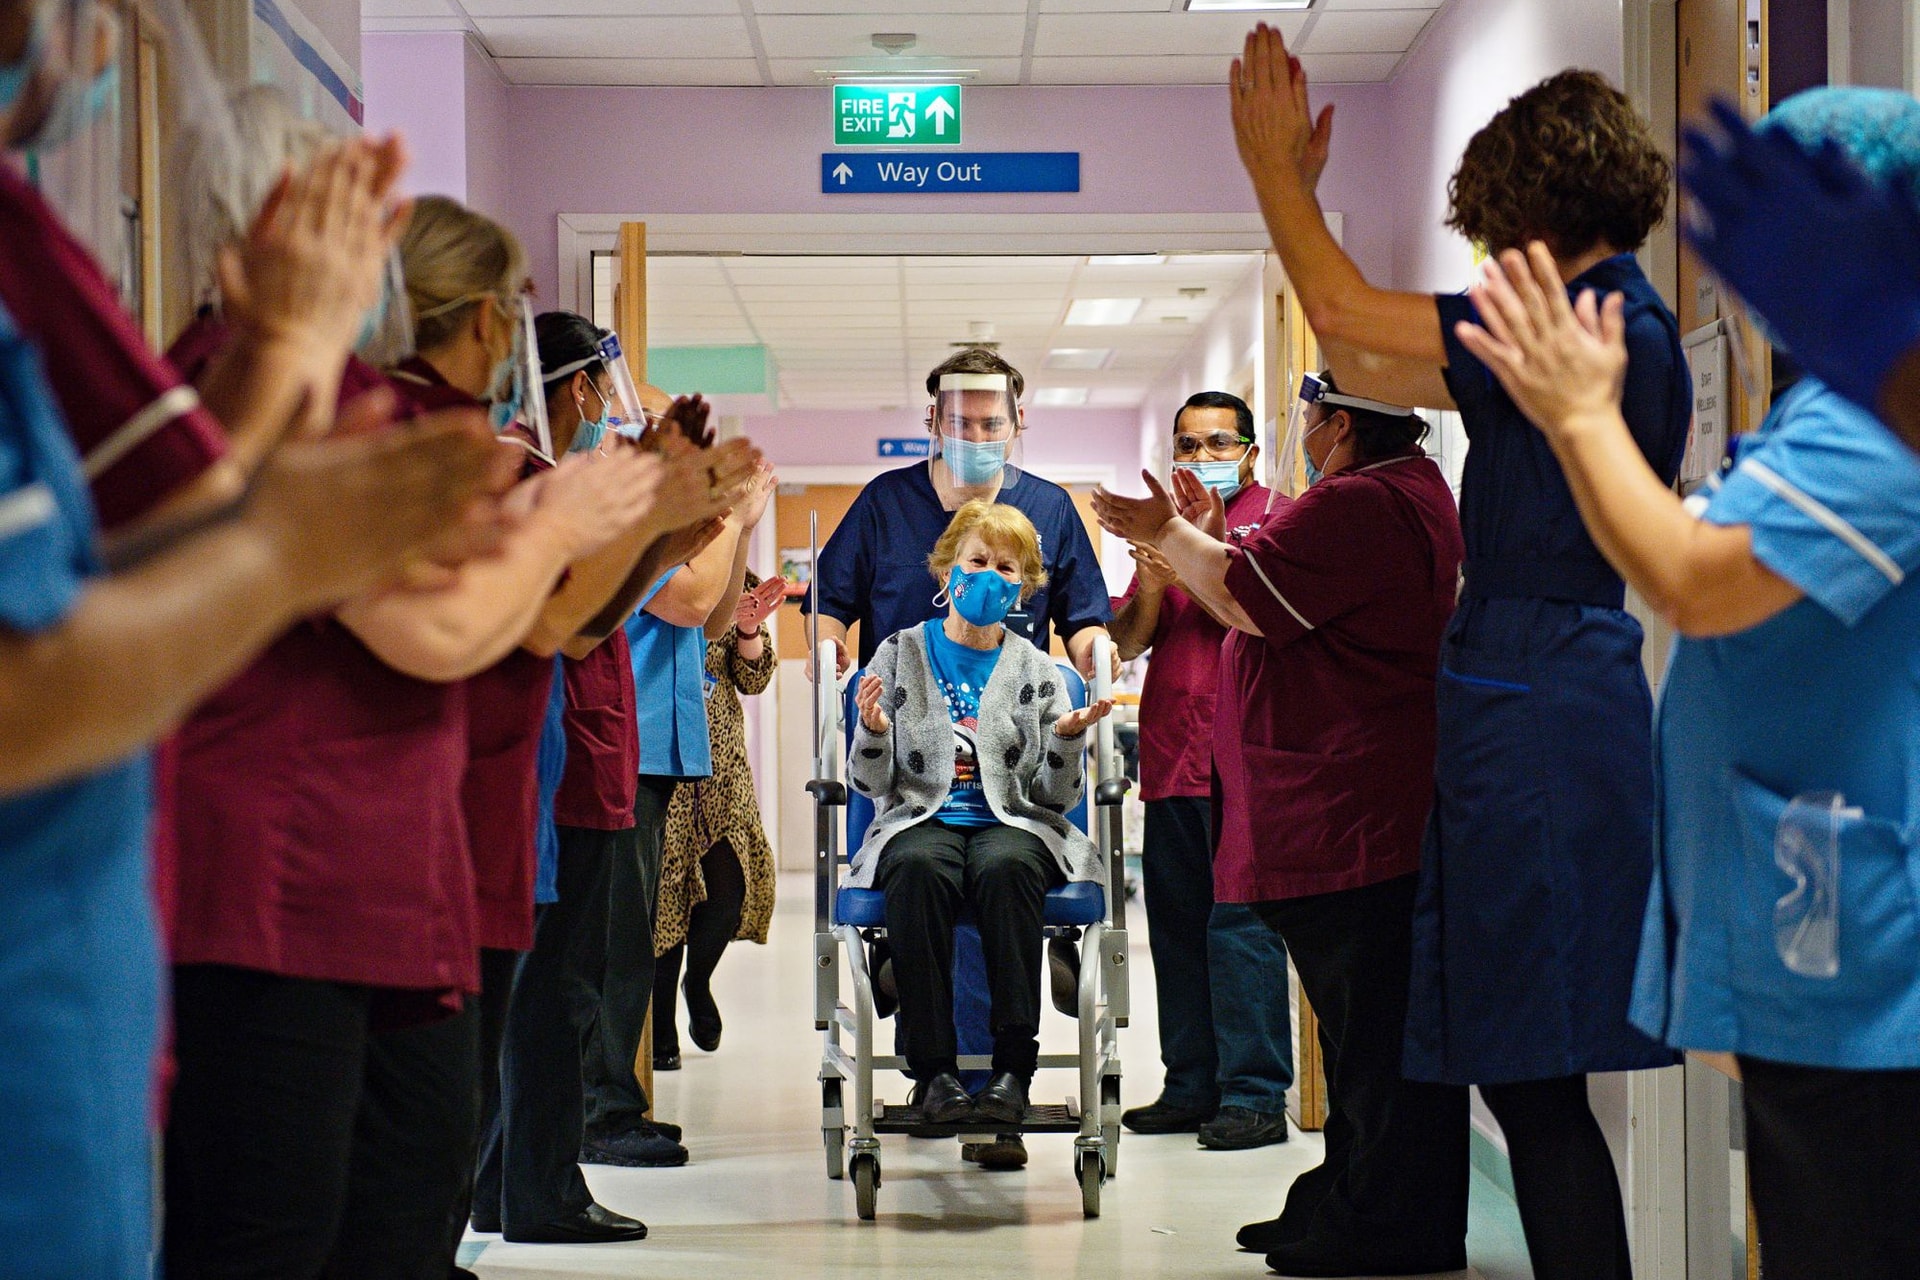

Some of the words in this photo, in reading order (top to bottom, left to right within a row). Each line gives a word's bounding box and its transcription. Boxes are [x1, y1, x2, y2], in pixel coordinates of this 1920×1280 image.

[841, 98, 884, 114] FIRE
[842, 117, 884, 132] EXIT
[877, 162, 929, 187] Way
[937, 161, 982, 182] Out
